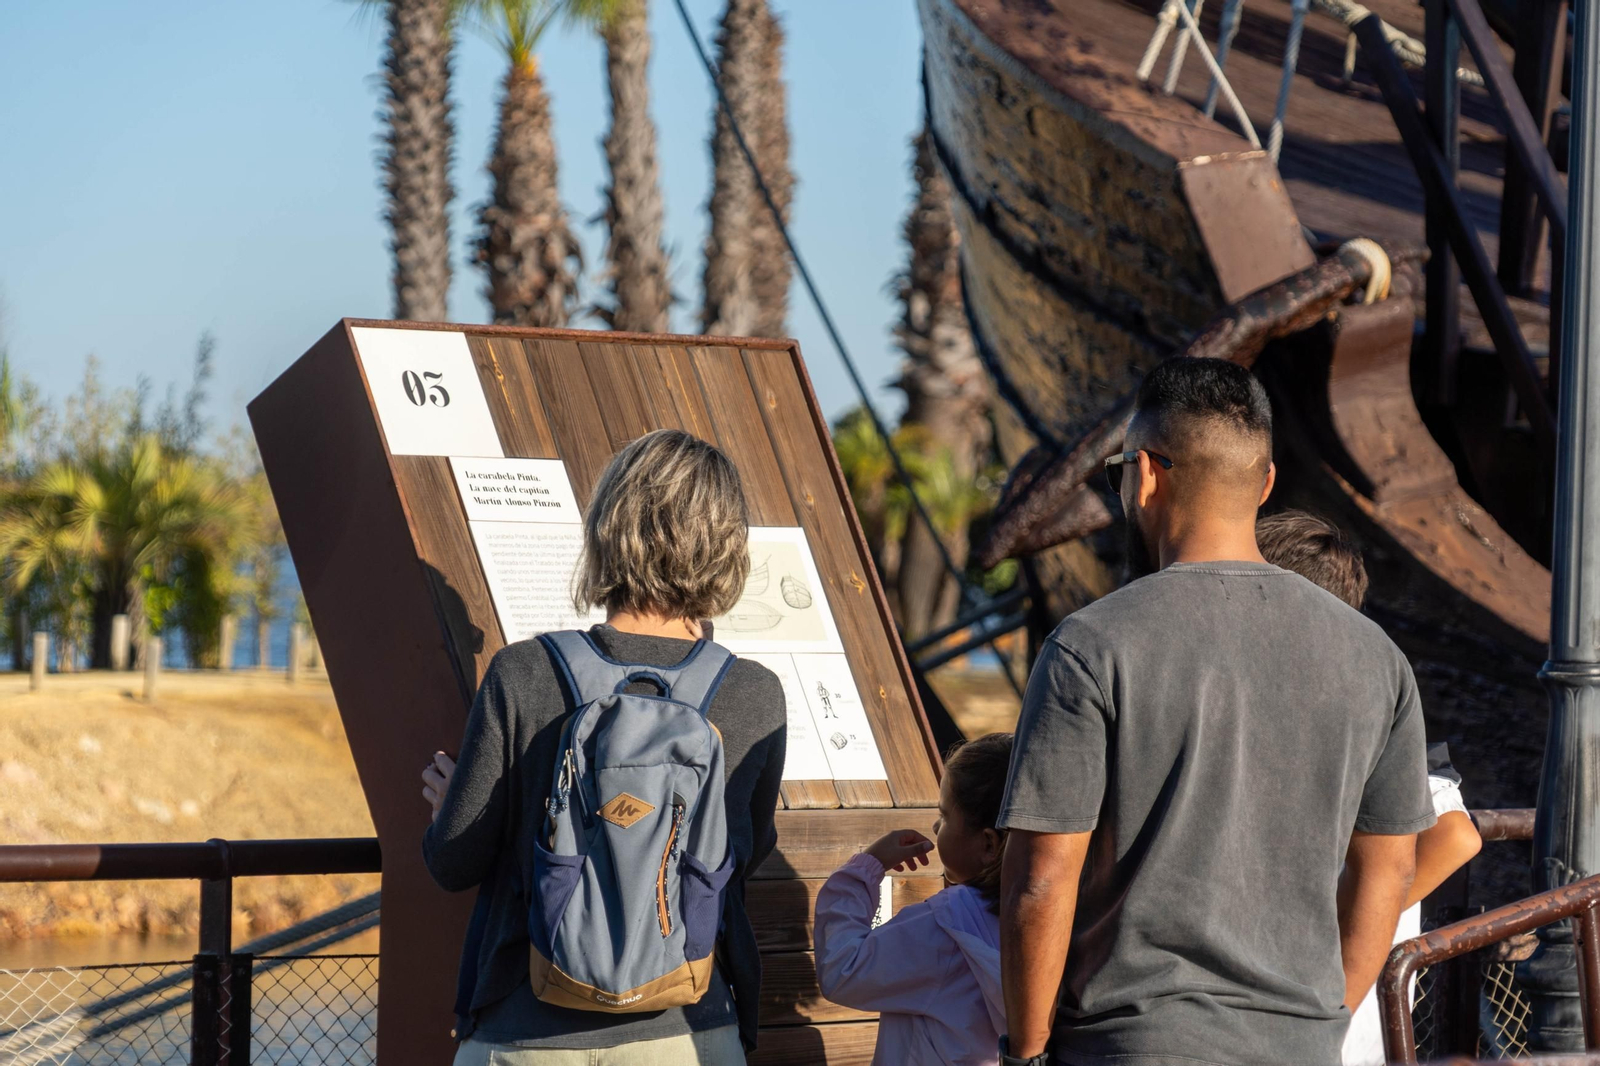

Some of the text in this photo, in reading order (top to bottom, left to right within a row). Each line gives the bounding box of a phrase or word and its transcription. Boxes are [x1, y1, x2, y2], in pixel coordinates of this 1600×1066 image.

[465, 470, 476, 479] La
[478, 472, 515, 481] carabela
[469, 484, 480, 492] La
[482, 485, 501, 493] nave
[504, 485, 517, 493] del
[505, 498, 532, 506] Alonso
[596, 994, 643, 1006] Quechua
